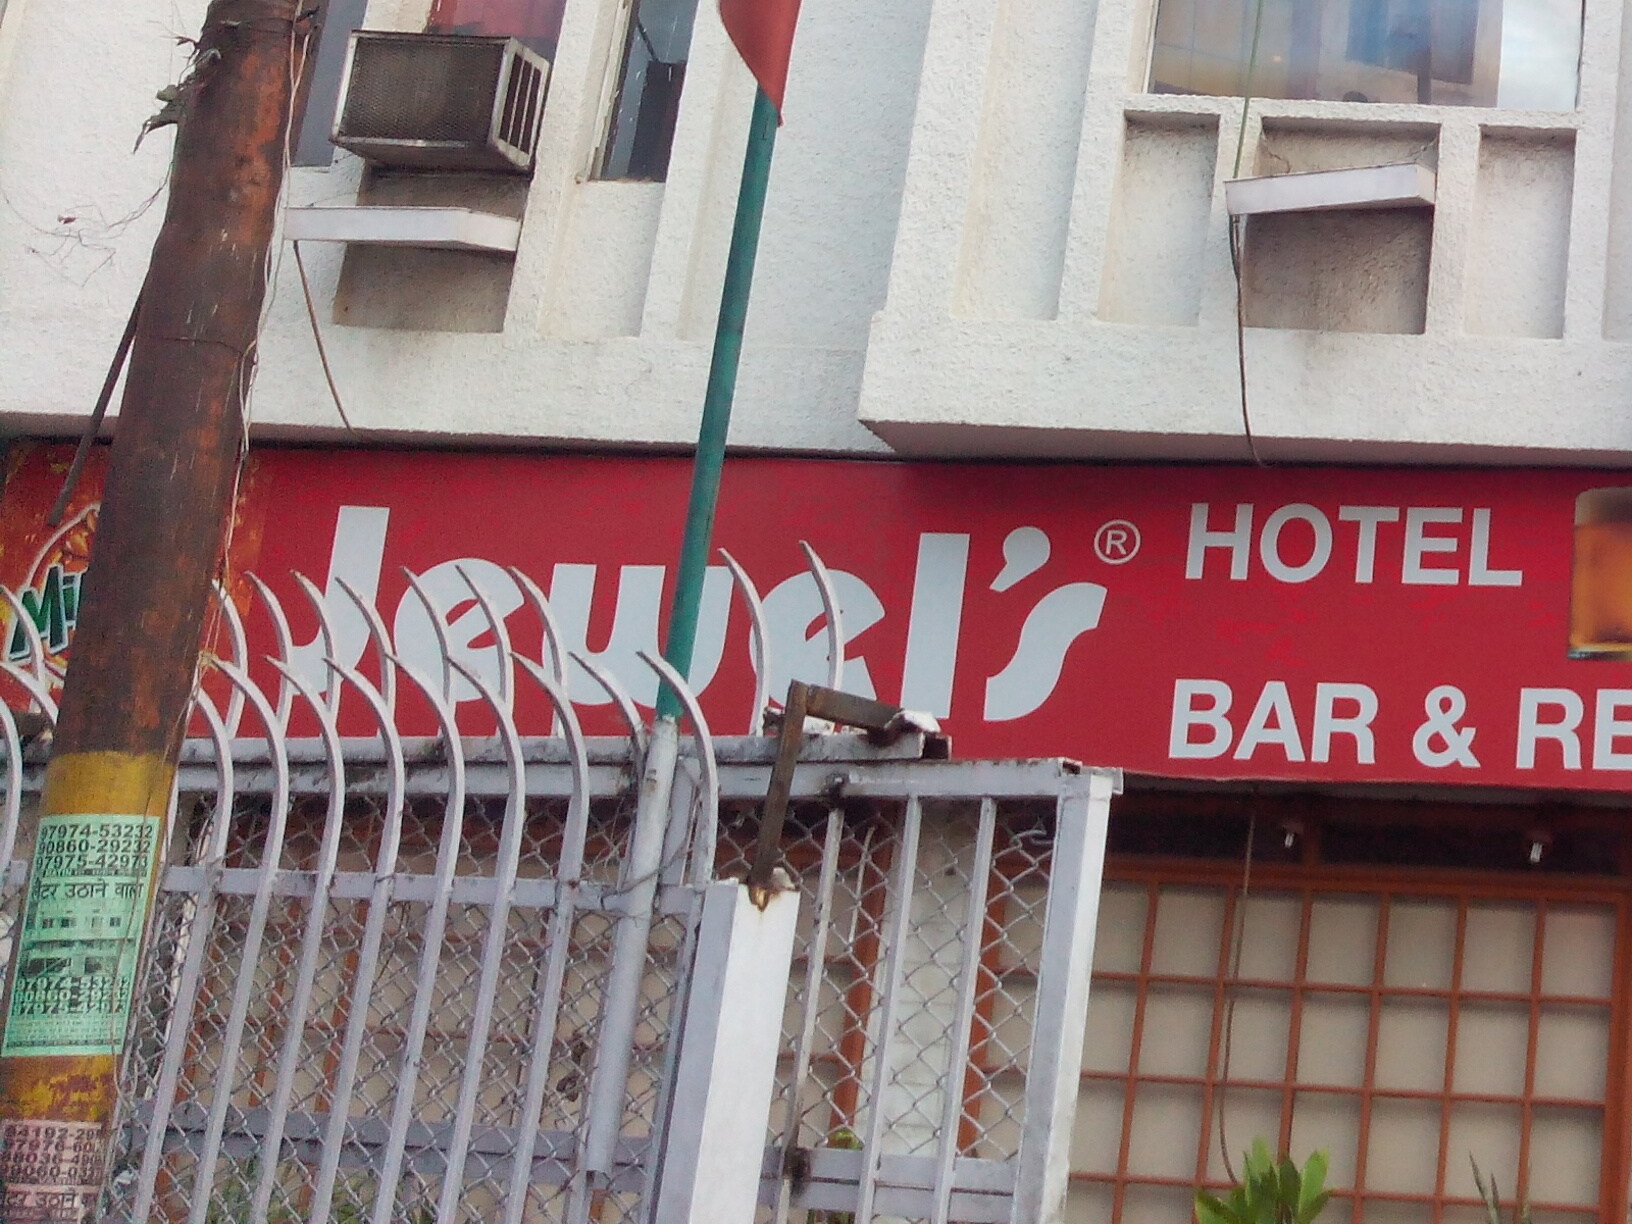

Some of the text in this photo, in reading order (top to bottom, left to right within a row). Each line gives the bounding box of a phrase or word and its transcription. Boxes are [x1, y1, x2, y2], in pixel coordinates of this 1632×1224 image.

[1185, 502, 1523, 588] HOTEL
[1168, 677, 1381, 764] BAR
[1411, 684, 1481, 769] &
